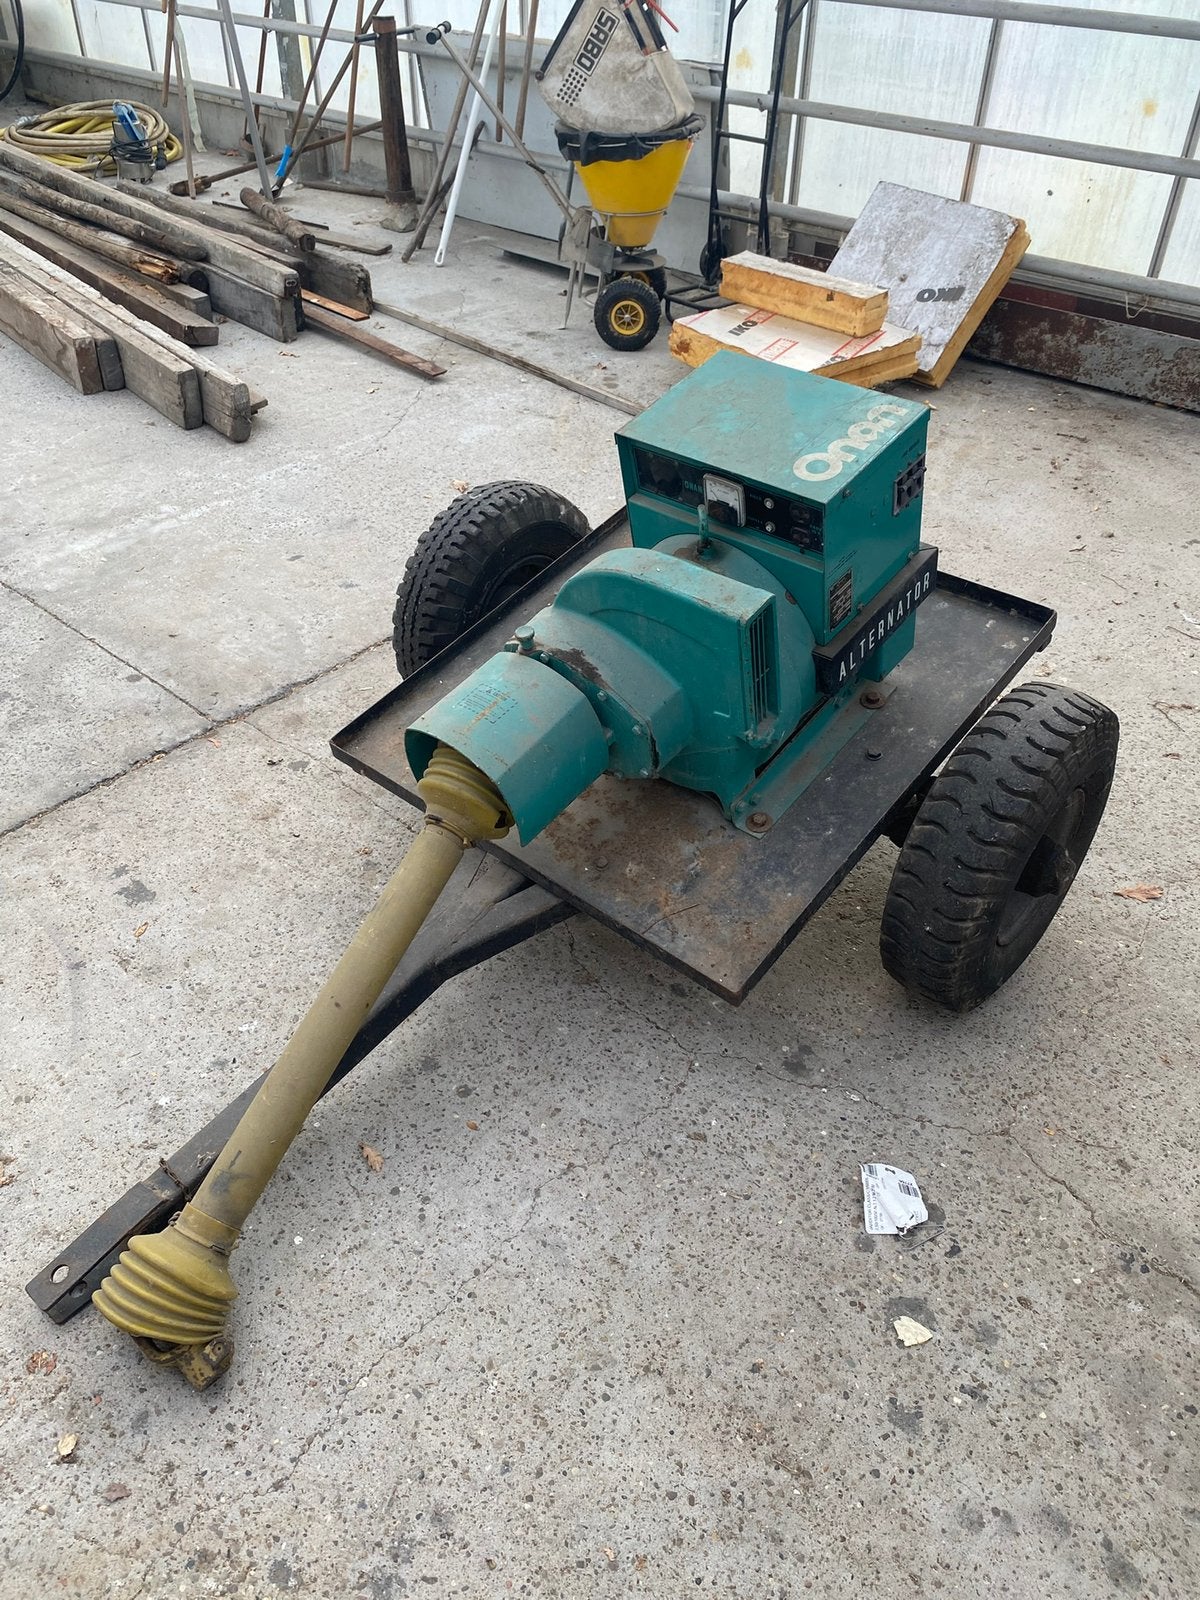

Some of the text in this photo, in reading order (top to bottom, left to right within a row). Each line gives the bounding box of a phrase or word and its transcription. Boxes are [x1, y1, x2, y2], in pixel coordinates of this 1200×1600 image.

[577, 10, 617, 73] SABO
[915, 285, 967, 303] IKO
[728, 319, 759, 337] IKO
[838, 570, 931, 682] ALTERNATOR
